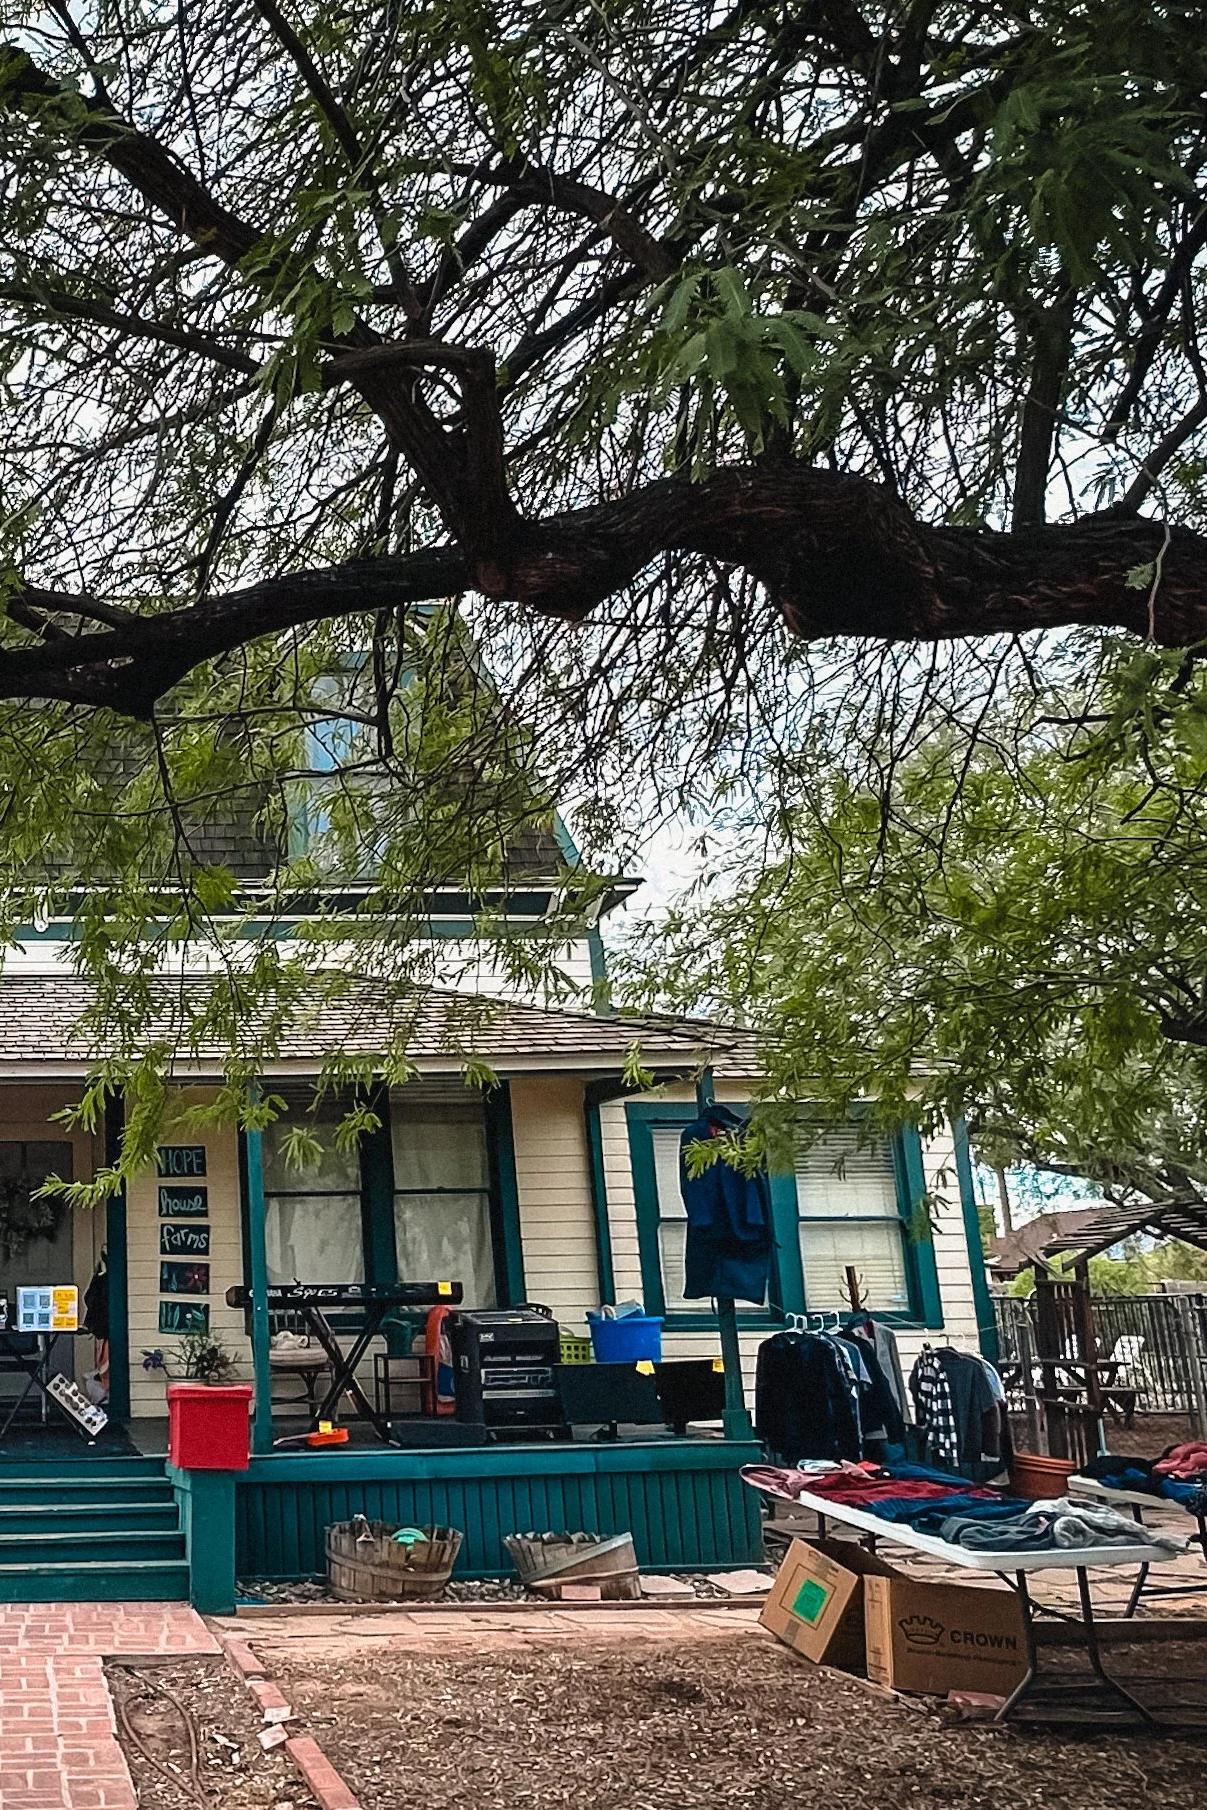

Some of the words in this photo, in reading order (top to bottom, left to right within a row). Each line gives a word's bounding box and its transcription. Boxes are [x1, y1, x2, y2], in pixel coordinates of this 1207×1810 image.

[160, 1149, 203, 1174] HOPE
[160, 1188, 207, 1215] house
[161, 1225, 209, 1251] farms
[949, 1629, 1018, 1650] CROWN
